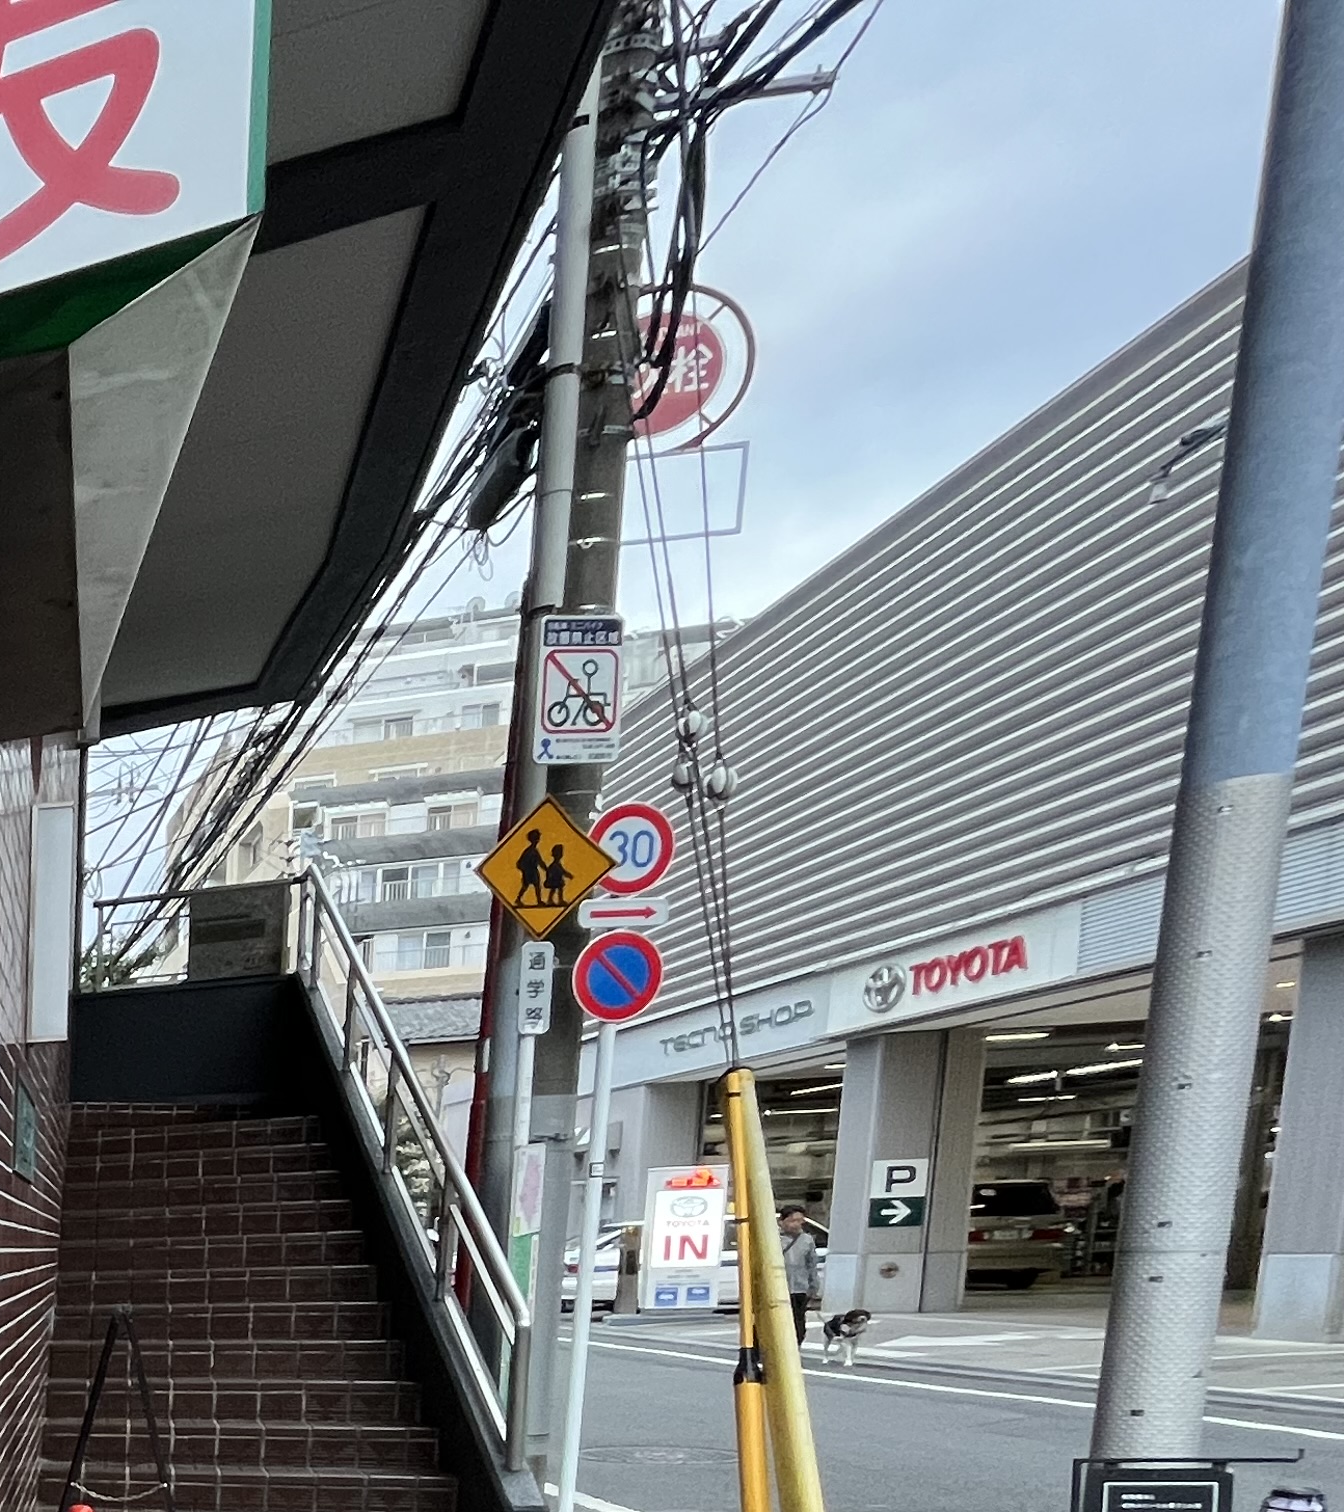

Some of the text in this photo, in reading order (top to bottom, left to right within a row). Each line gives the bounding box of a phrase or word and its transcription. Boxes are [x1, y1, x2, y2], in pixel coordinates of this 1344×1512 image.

[610, 829, 655, 869] 30
[909, 935, 1029, 996] TOYOTA
[739, 1000, 816, 1036] SHOP
[885, 1165, 917, 1193] P
[663, 1234, 709, 1261] IN
